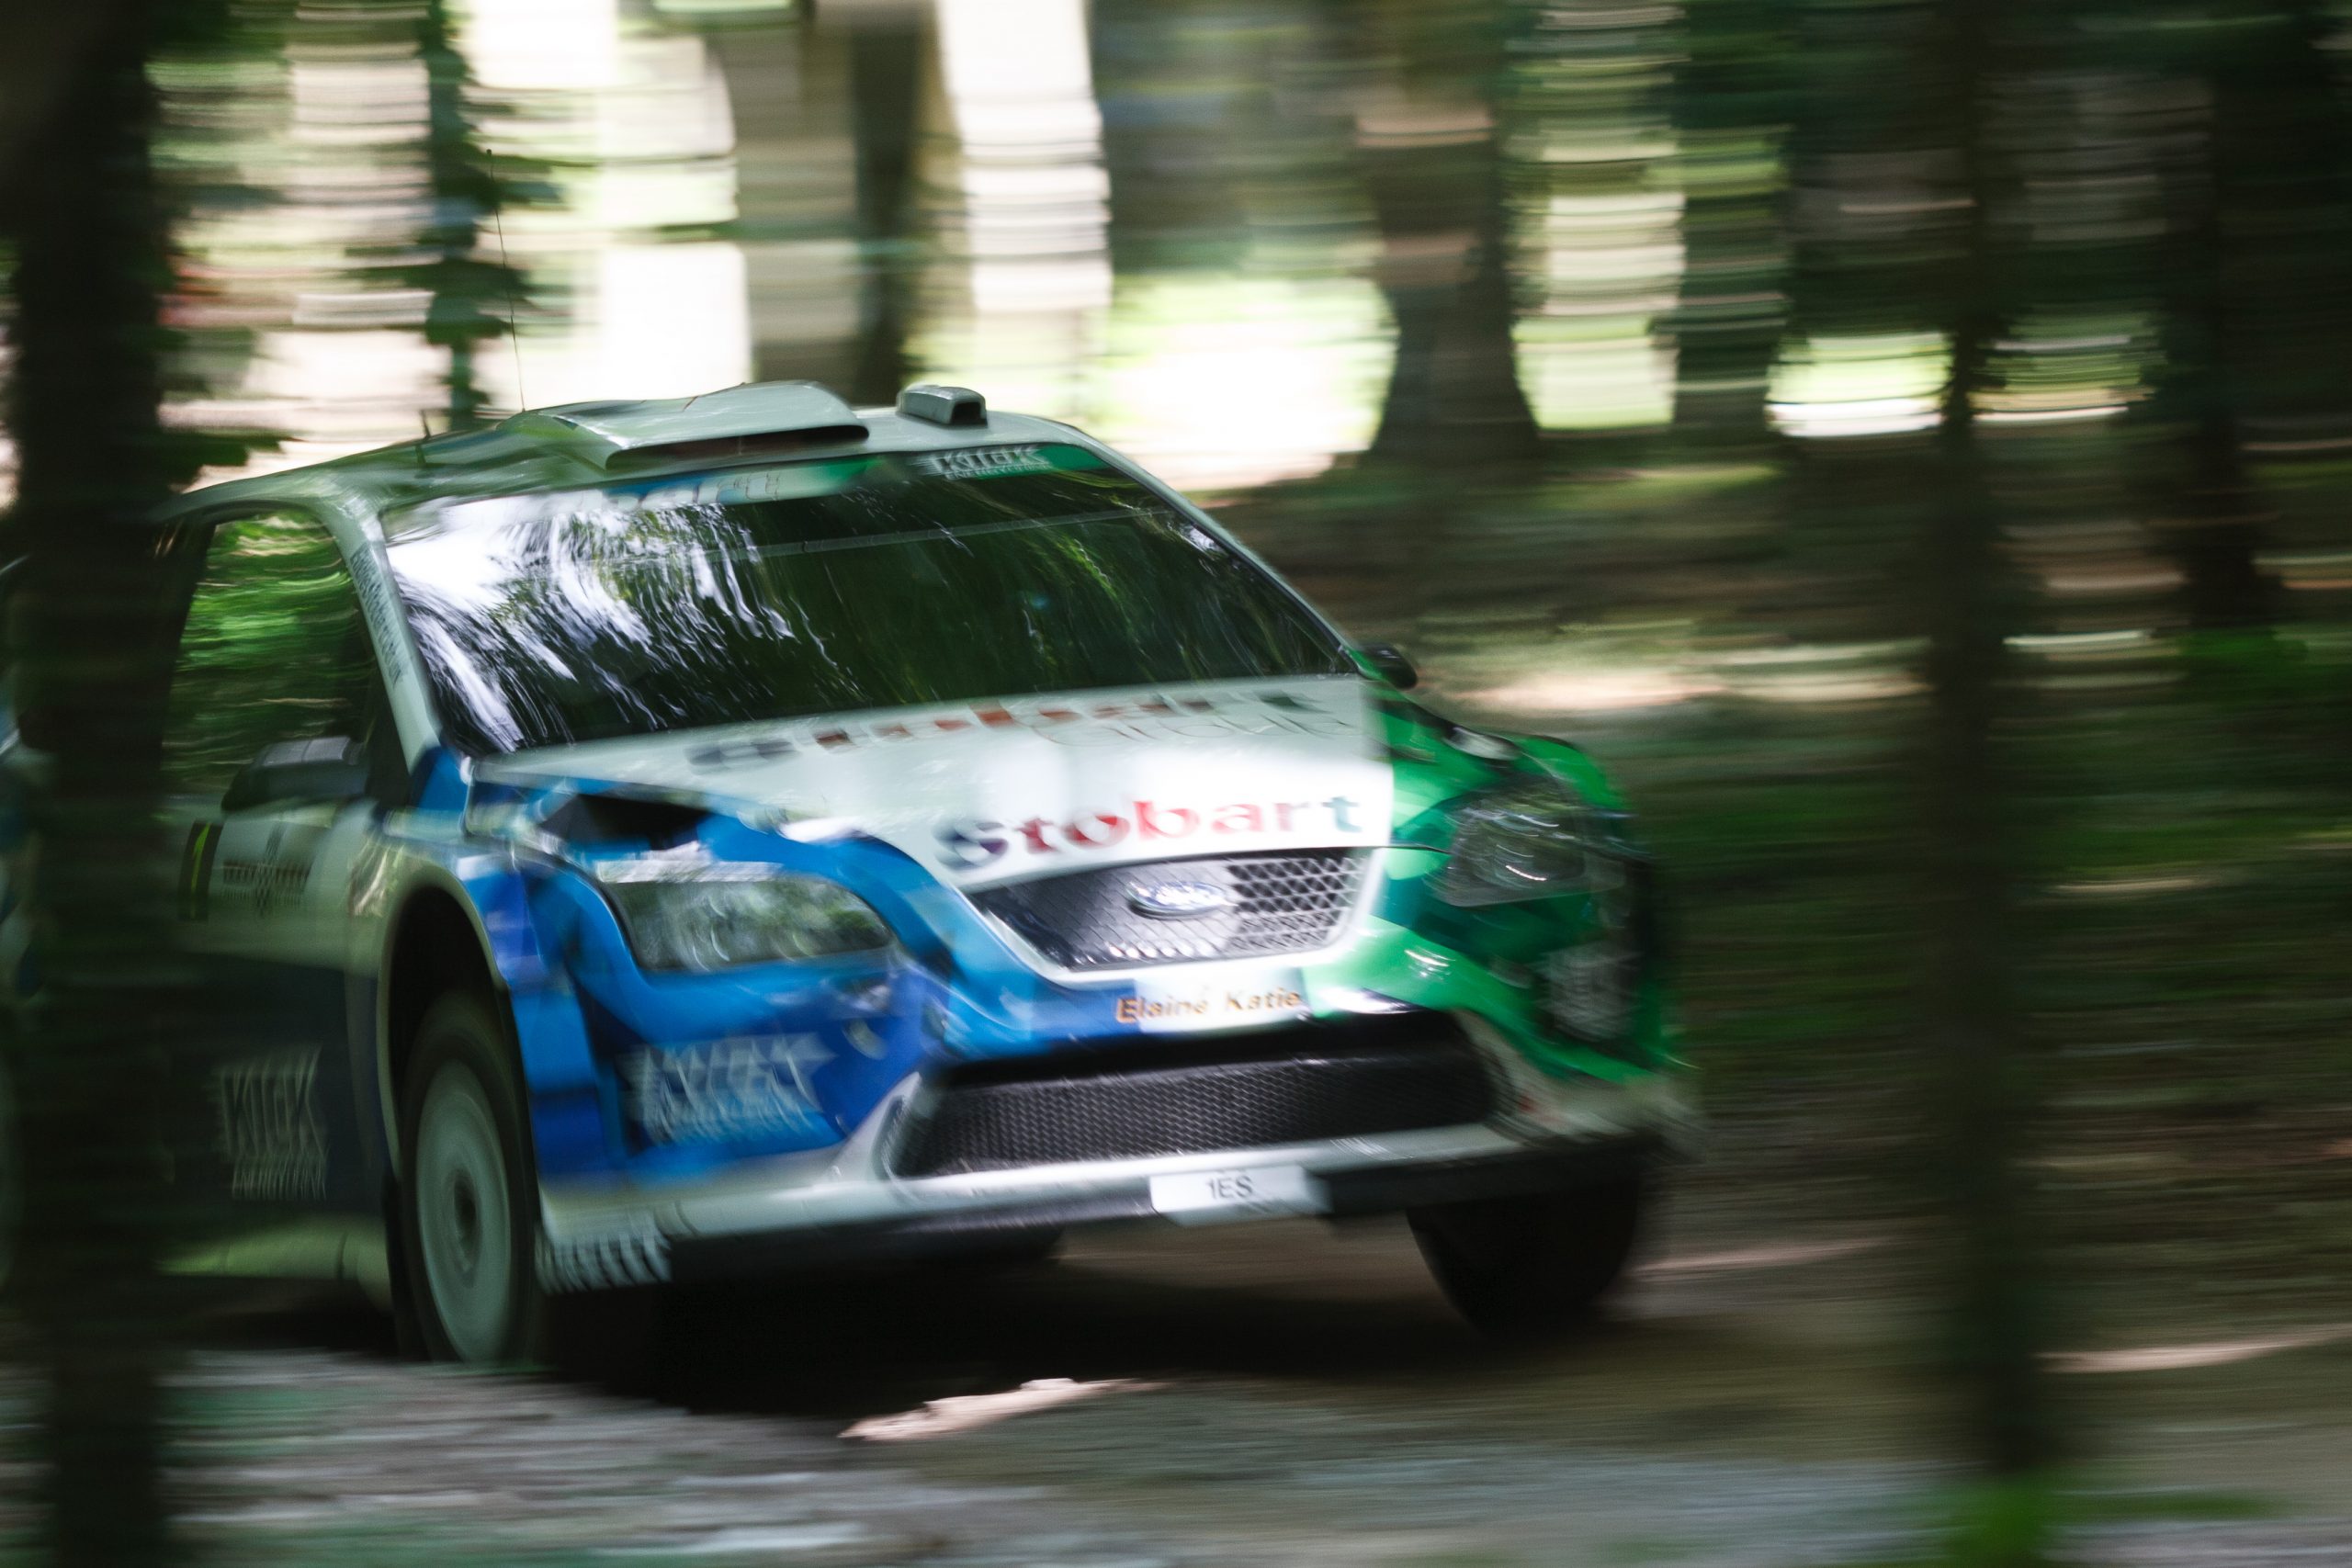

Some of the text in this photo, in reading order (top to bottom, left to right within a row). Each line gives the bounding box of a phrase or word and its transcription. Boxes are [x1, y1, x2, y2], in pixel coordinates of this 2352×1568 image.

[934, 795, 1364, 873] Stobart
[1115, 987, 1303, 1023] Elaine Katie
